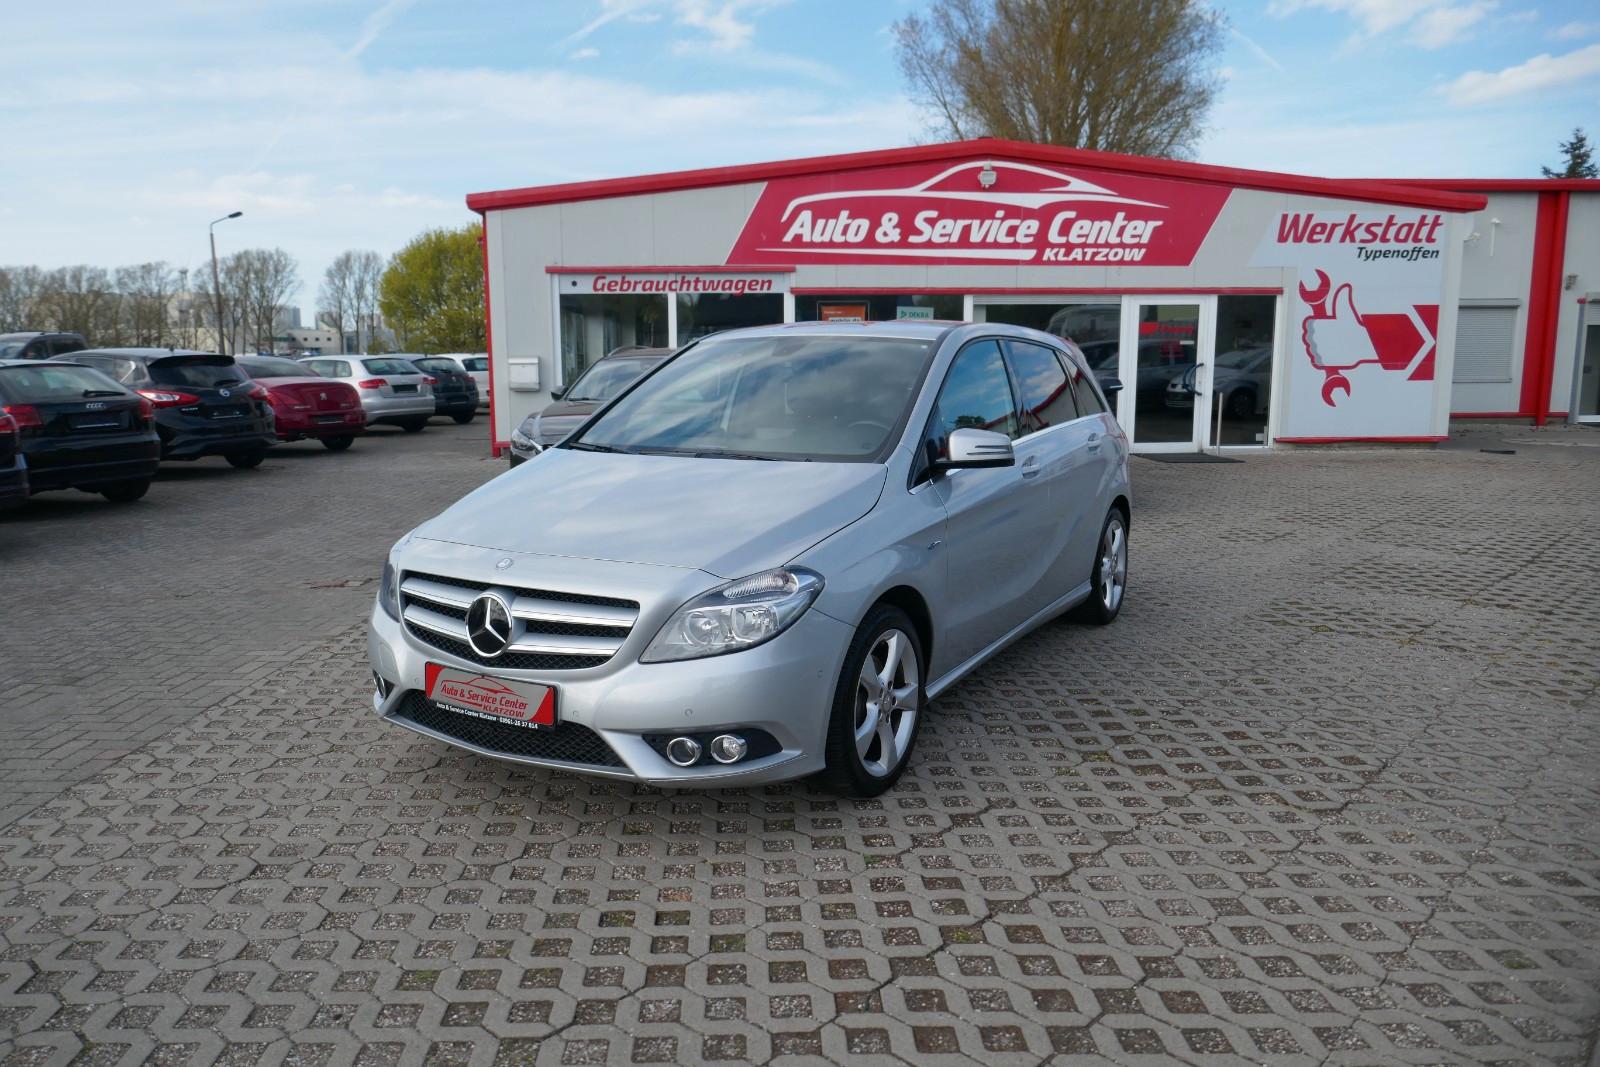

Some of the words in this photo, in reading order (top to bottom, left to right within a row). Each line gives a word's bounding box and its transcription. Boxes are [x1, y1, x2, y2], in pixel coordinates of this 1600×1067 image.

[783, 209, 869, 243] Auto
[875, 210, 911, 242] &
[909, 209, 1039, 243] Service
[1048, 210, 1163, 244] Center
[1277, 213, 1443, 243] Werkstatt
[1042, 248, 1146, 261] KLATZOW
[1356, 246, 1439, 262] Typenoffen
[592, 275, 773, 296] Gebrauchtwagen
[441, 684, 459, 697] Auto
[459, 690, 465, 698] &
[467, 690, 497, 704] Service
[499, 696, 528, 709] Center
[483, 705, 525, 718] KLATZOW
